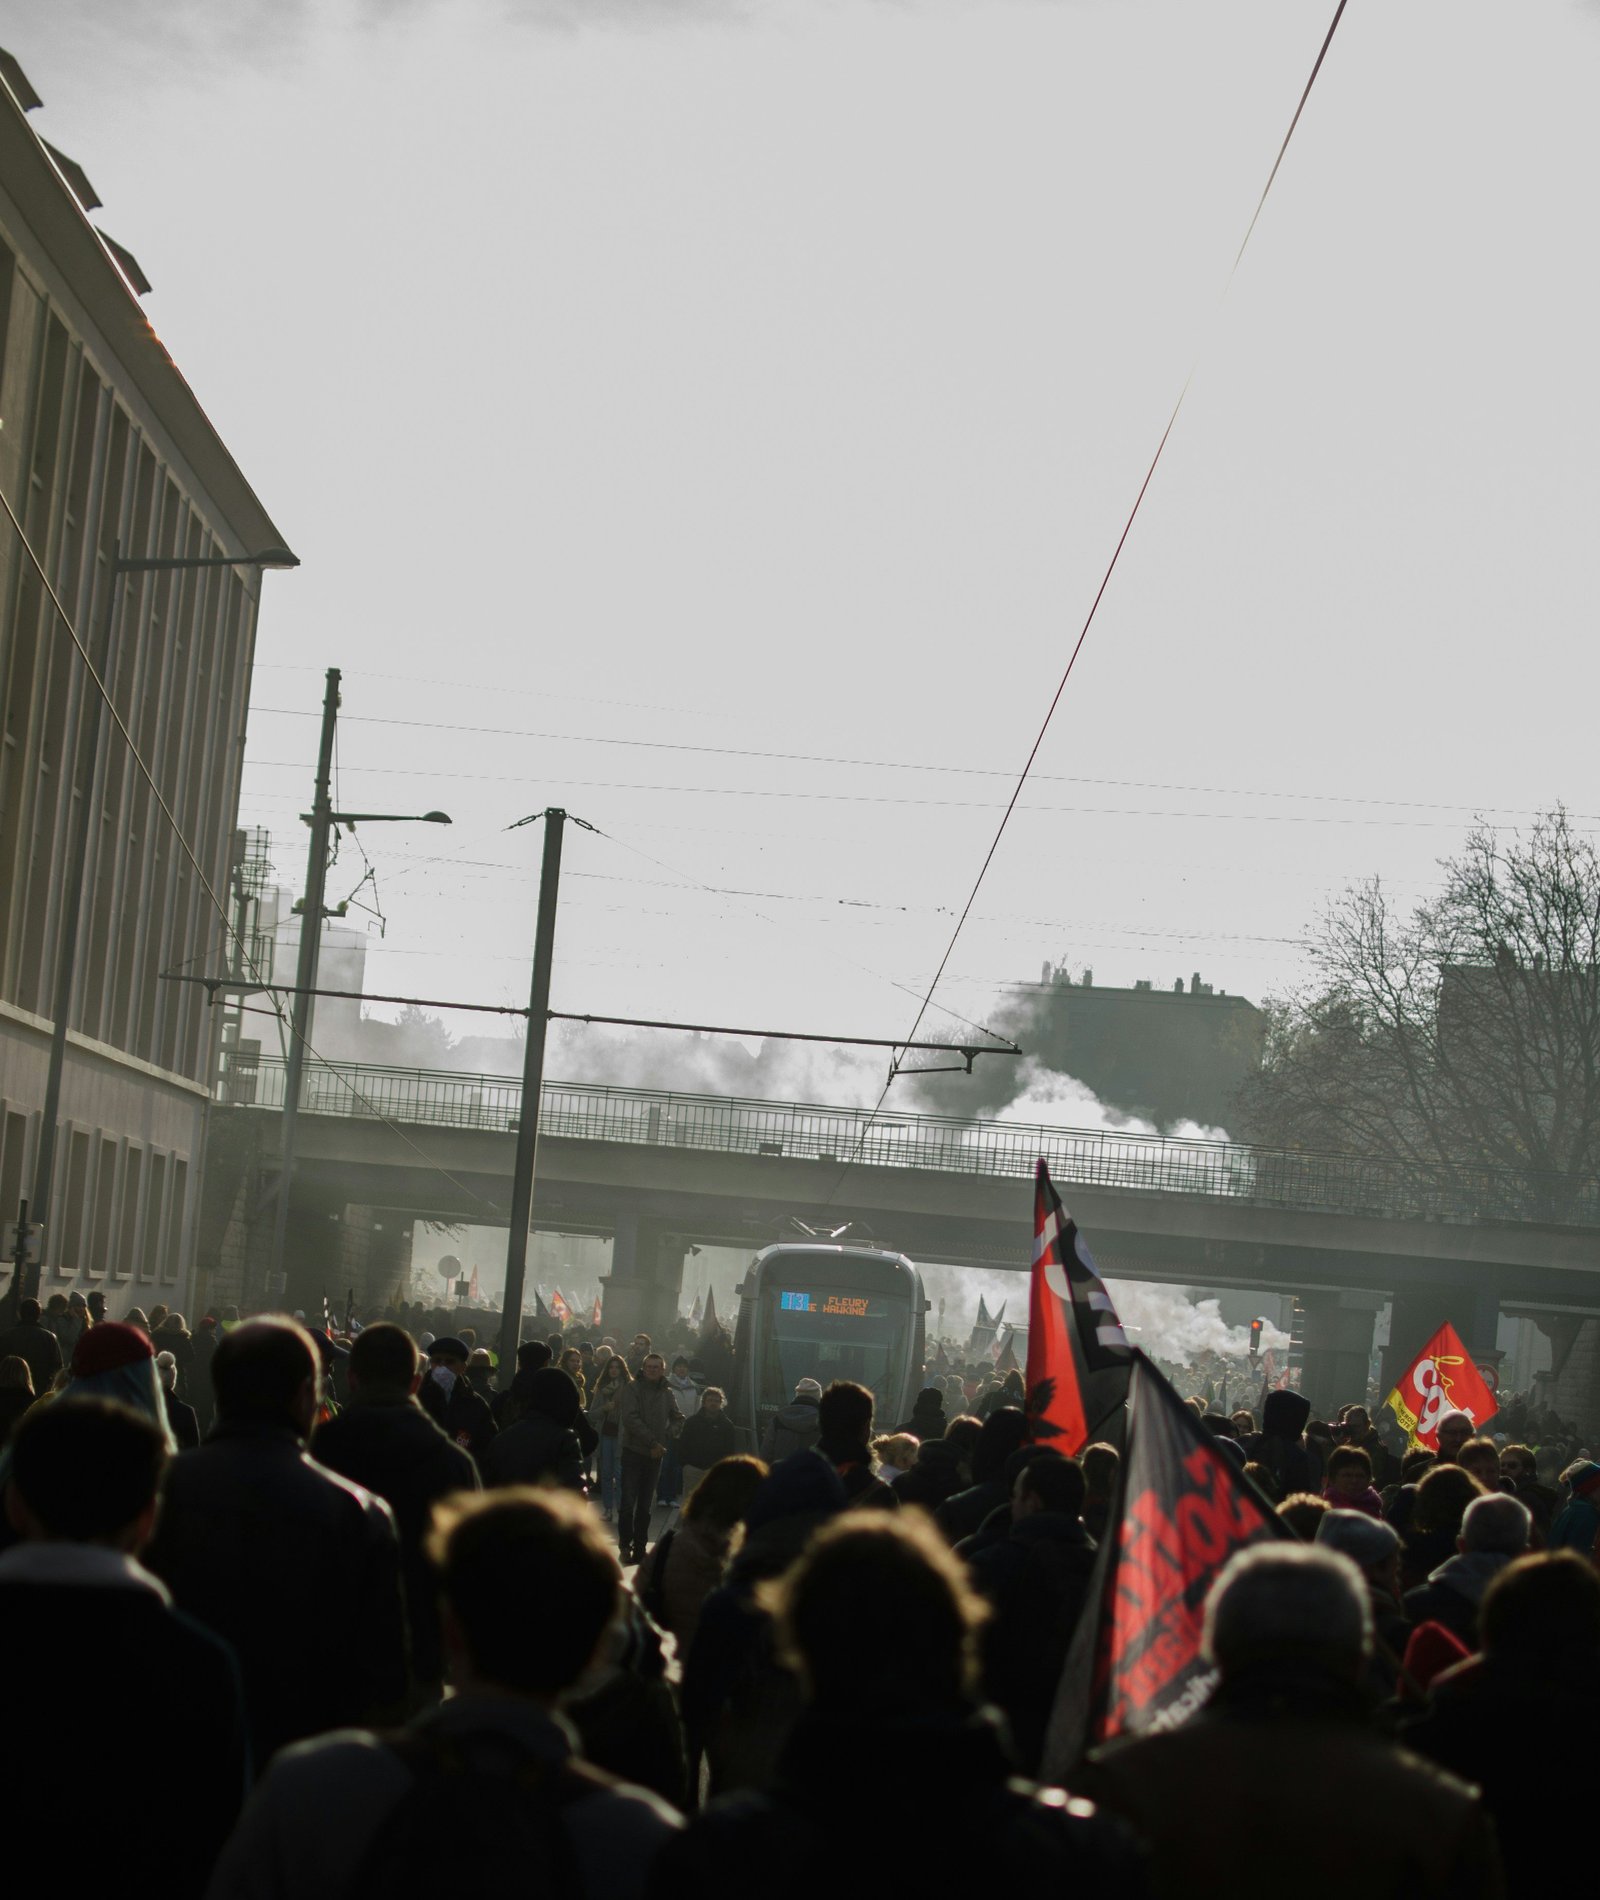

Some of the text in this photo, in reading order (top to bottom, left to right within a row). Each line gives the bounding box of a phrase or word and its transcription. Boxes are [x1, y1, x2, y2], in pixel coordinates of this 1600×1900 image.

[787, 1292, 805, 1311] T3
[828, 1296, 869, 1308] FLEURY
[822, 1303, 866, 1316] HAWKING
